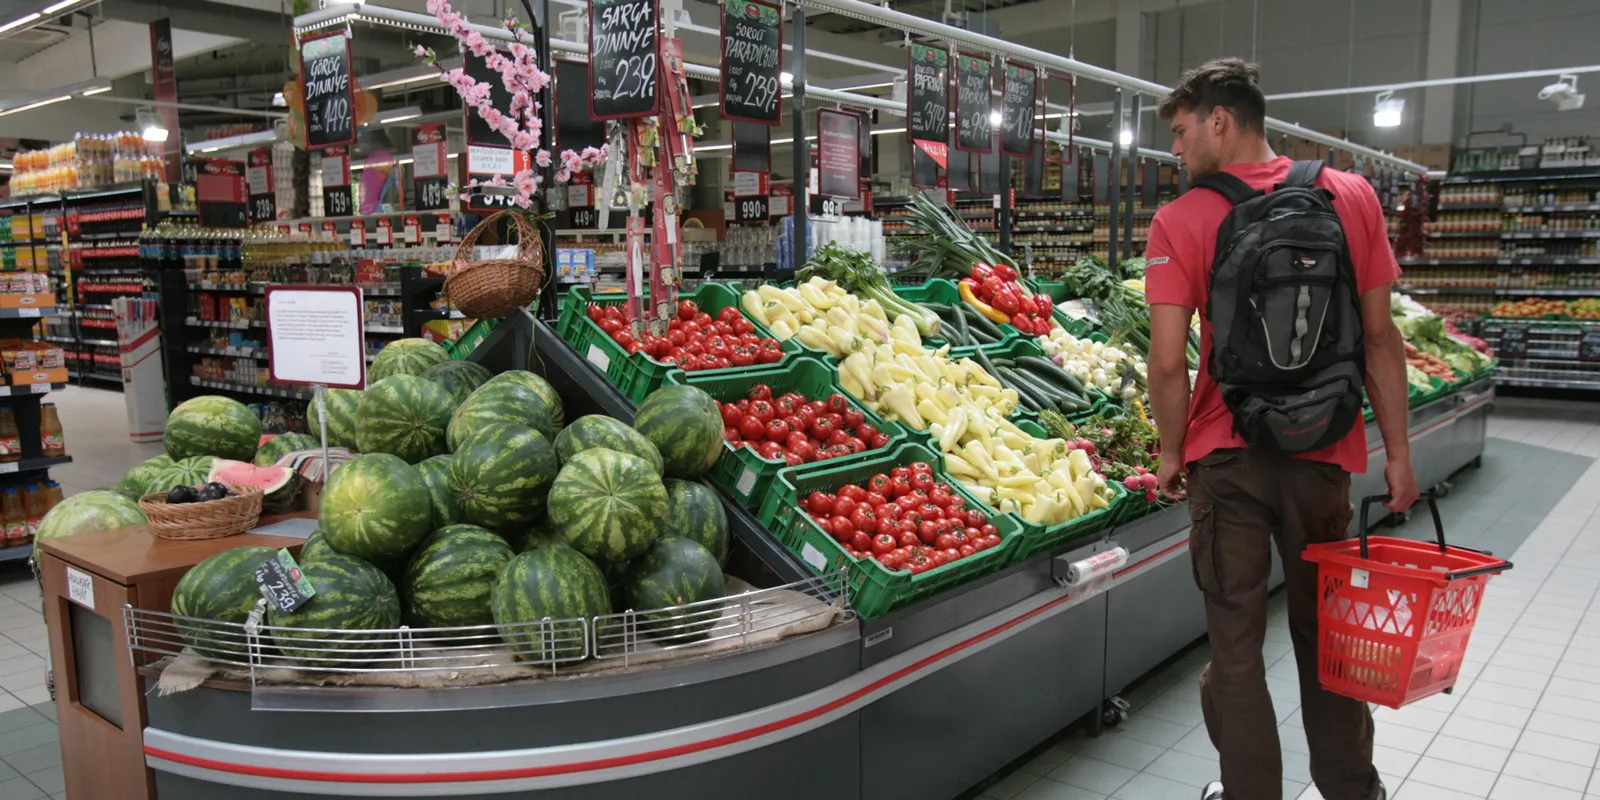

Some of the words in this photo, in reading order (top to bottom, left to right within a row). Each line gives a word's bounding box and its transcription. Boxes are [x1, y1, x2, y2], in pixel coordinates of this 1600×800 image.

[593, 26, 655, 56] DINNYE
[310, 56, 340, 80] GÖRÖG
[306, 74, 348, 101] DINNYE
[914, 73, 945, 97] PAPRIKA
[329, 191, 346, 213] 759
[422, 183, 440, 206] 489
[256, 200, 270, 219] 239
[574, 210, 589, 226] 449
[742, 200, 761, 218] 990
